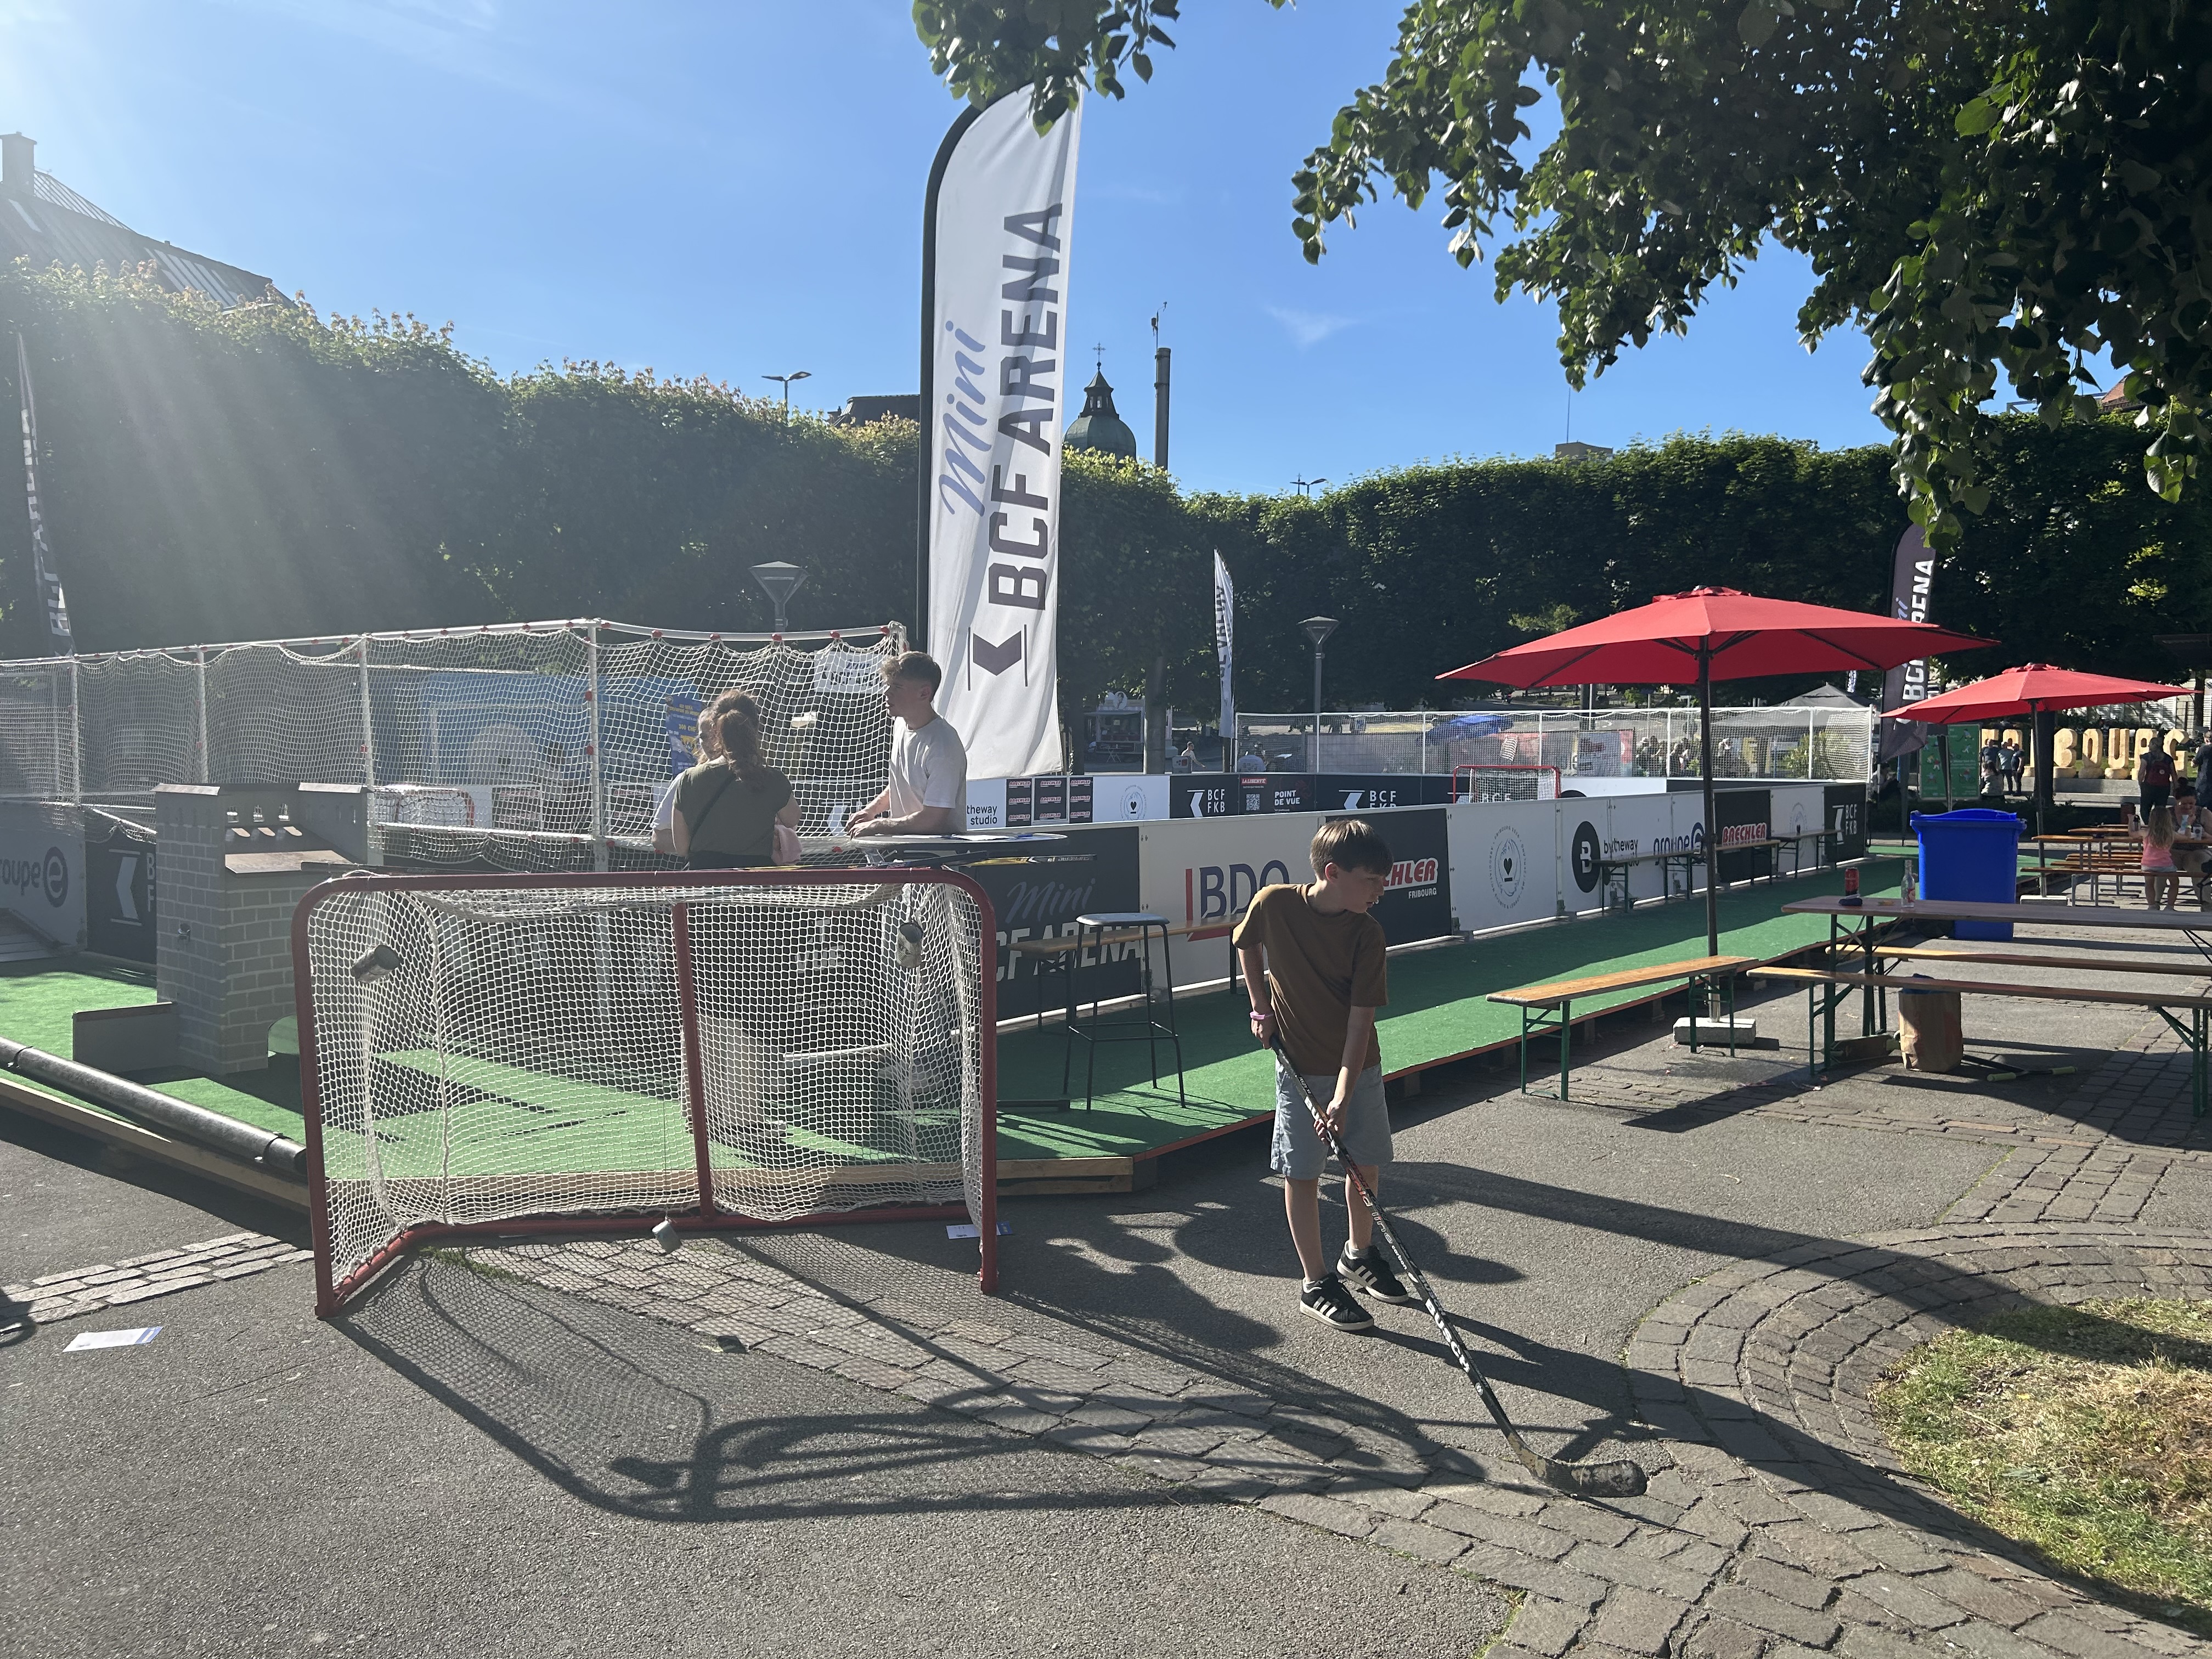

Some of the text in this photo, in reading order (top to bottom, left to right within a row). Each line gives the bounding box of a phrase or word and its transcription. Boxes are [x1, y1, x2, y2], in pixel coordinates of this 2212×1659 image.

[988, 202, 1064, 611] BCF ARENA
[939, 320, 993, 517] Mini
[1903, 560, 1934, 701] BC RENA
[1207, 789, 1226, 801] BCF
[1274, 790, 1296, 798] POINT
[1286, 797, 1300, 805] VUE
[1369, 791, 1397, 802] BCF
[967, 804, 997, 816] theway
[1207, 801, 1226, 813] FKB
[1846, 804, 1857, 819] BCF
[970, 815, 997, 825] studio
[1846, 820, 1857, 836] FKB
[0, 859, 41, 896] oupe
[1383, 860, 1436, 887] HLER
[1005, 878, 1096, 924] Mini
[1408, 887, 1438, 899] FRIBOURG
[1304, 1096, 1340, 1155] BUCH
[1391, 1245, 1408, 1270] carbon
[1425, 1298, 1470, 1373] BUSCH
